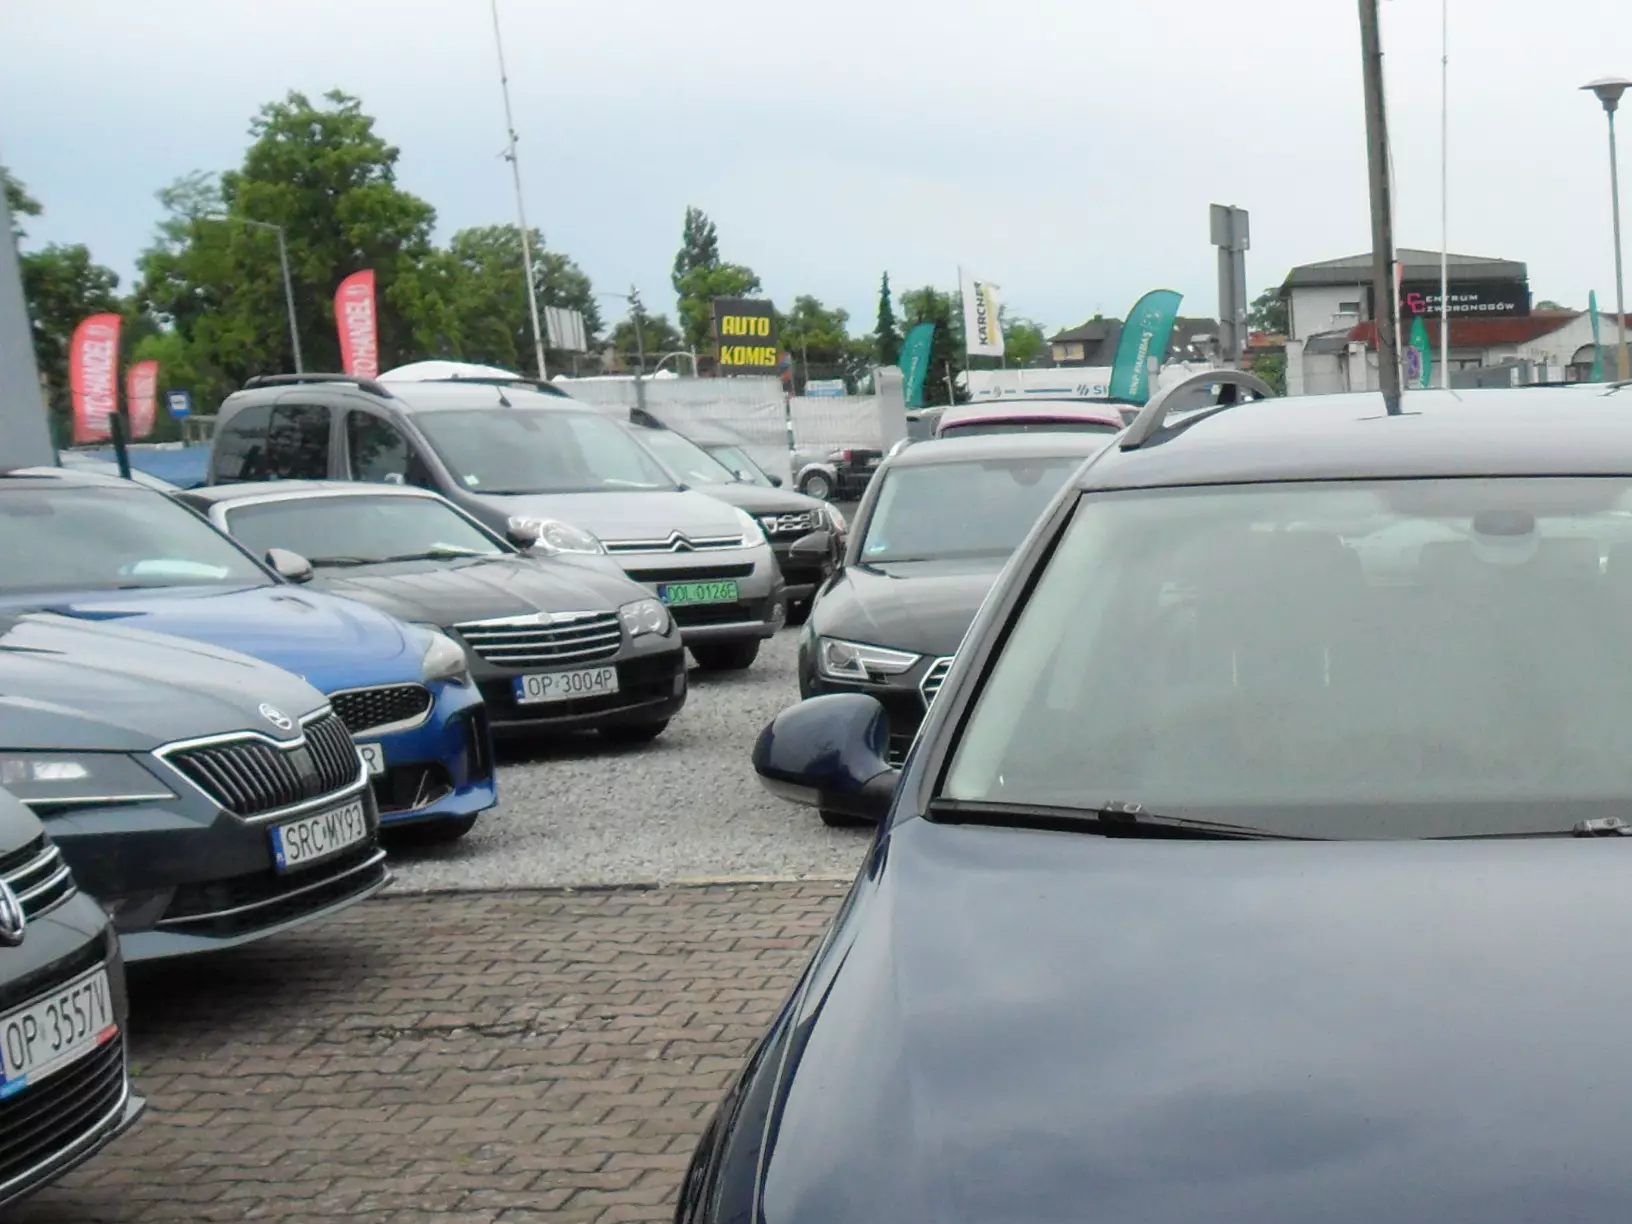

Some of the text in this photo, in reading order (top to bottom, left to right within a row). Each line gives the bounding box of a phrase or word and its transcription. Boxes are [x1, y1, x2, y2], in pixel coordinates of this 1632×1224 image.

[721, 315, 770, 336] AUTO
[720, 346, 777, 366] KOMIS
[528, 669, 612, 696] OP 3004P
[286, 804, 363, 860] SRC MY93
[6, 978, 106, 1070] OP 3557V
